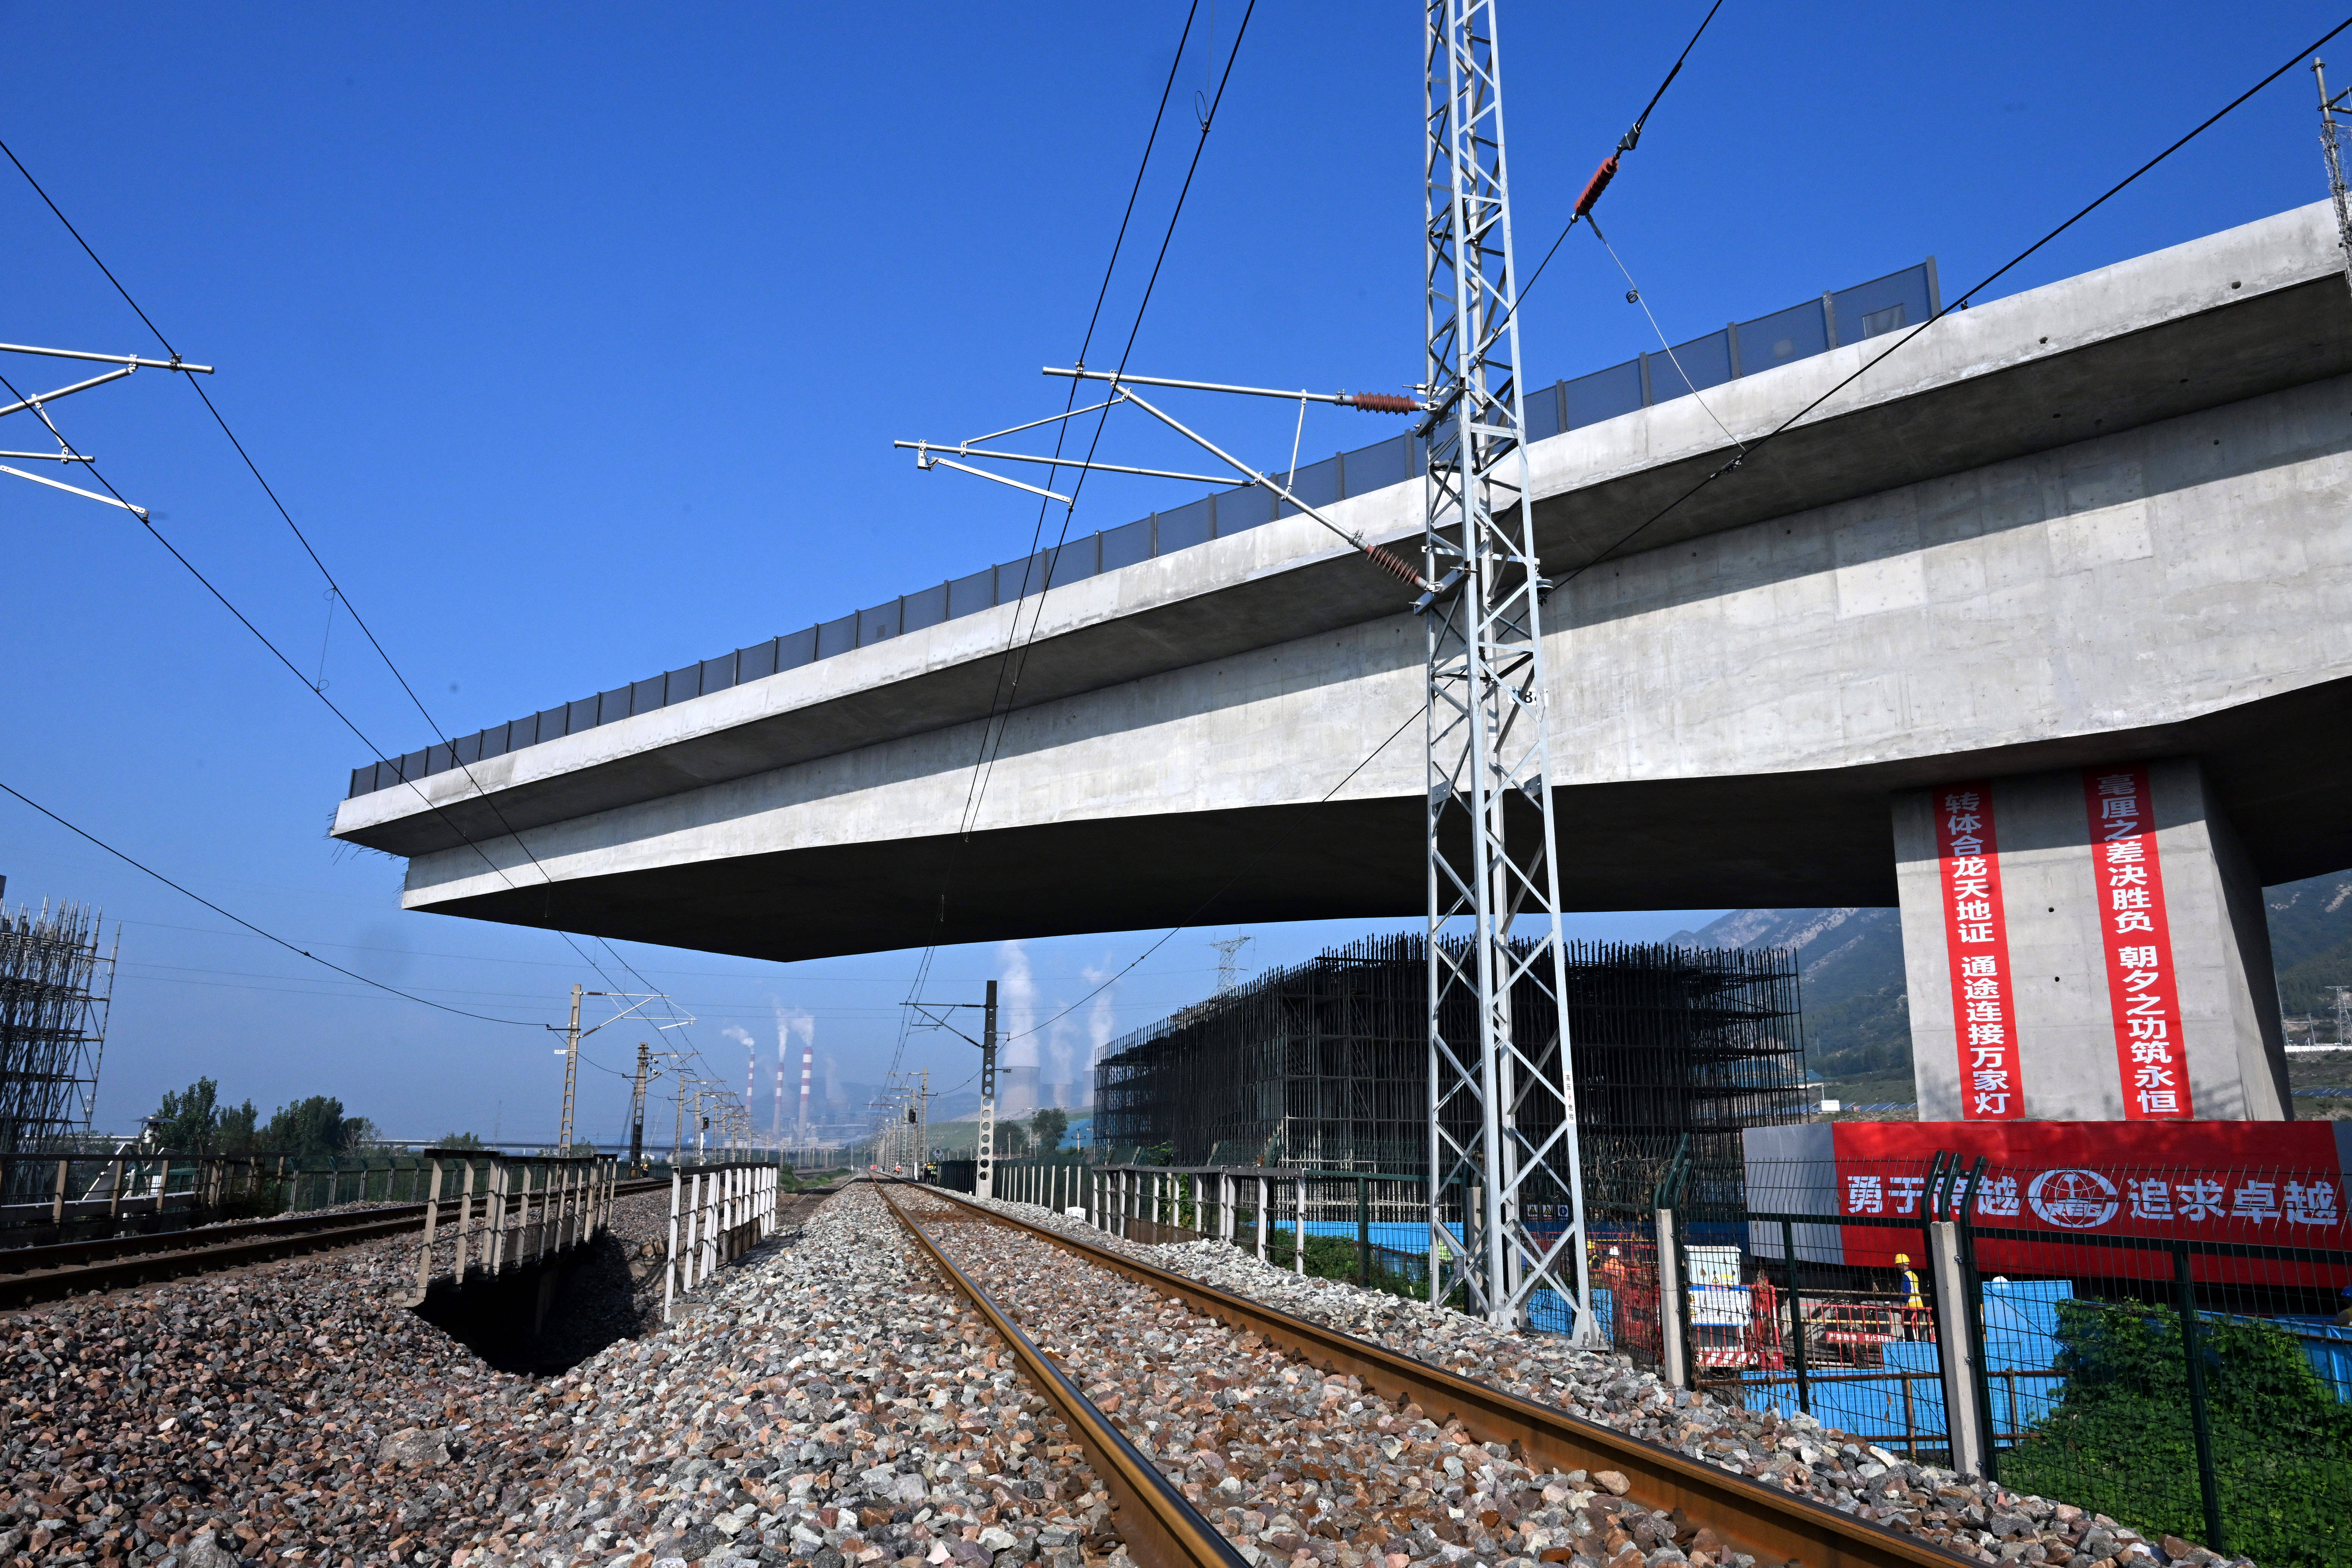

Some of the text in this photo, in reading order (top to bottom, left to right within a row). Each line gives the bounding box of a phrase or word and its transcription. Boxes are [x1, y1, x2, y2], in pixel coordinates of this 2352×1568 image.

[1945, 792, 2011, 1114] 转体合龙天地证 通途连接万家灯
[2097, 774, 2180, 1113] 毫厘之差决胜负 朝夕之功筑永恒
[1565, 1075, 1574, 1120] 高压 危险
[2127, 1178, 2338, 1225] 追求卓越
[1829, 1333, 1892, 1342] 严禁抛物 禁止跨越
